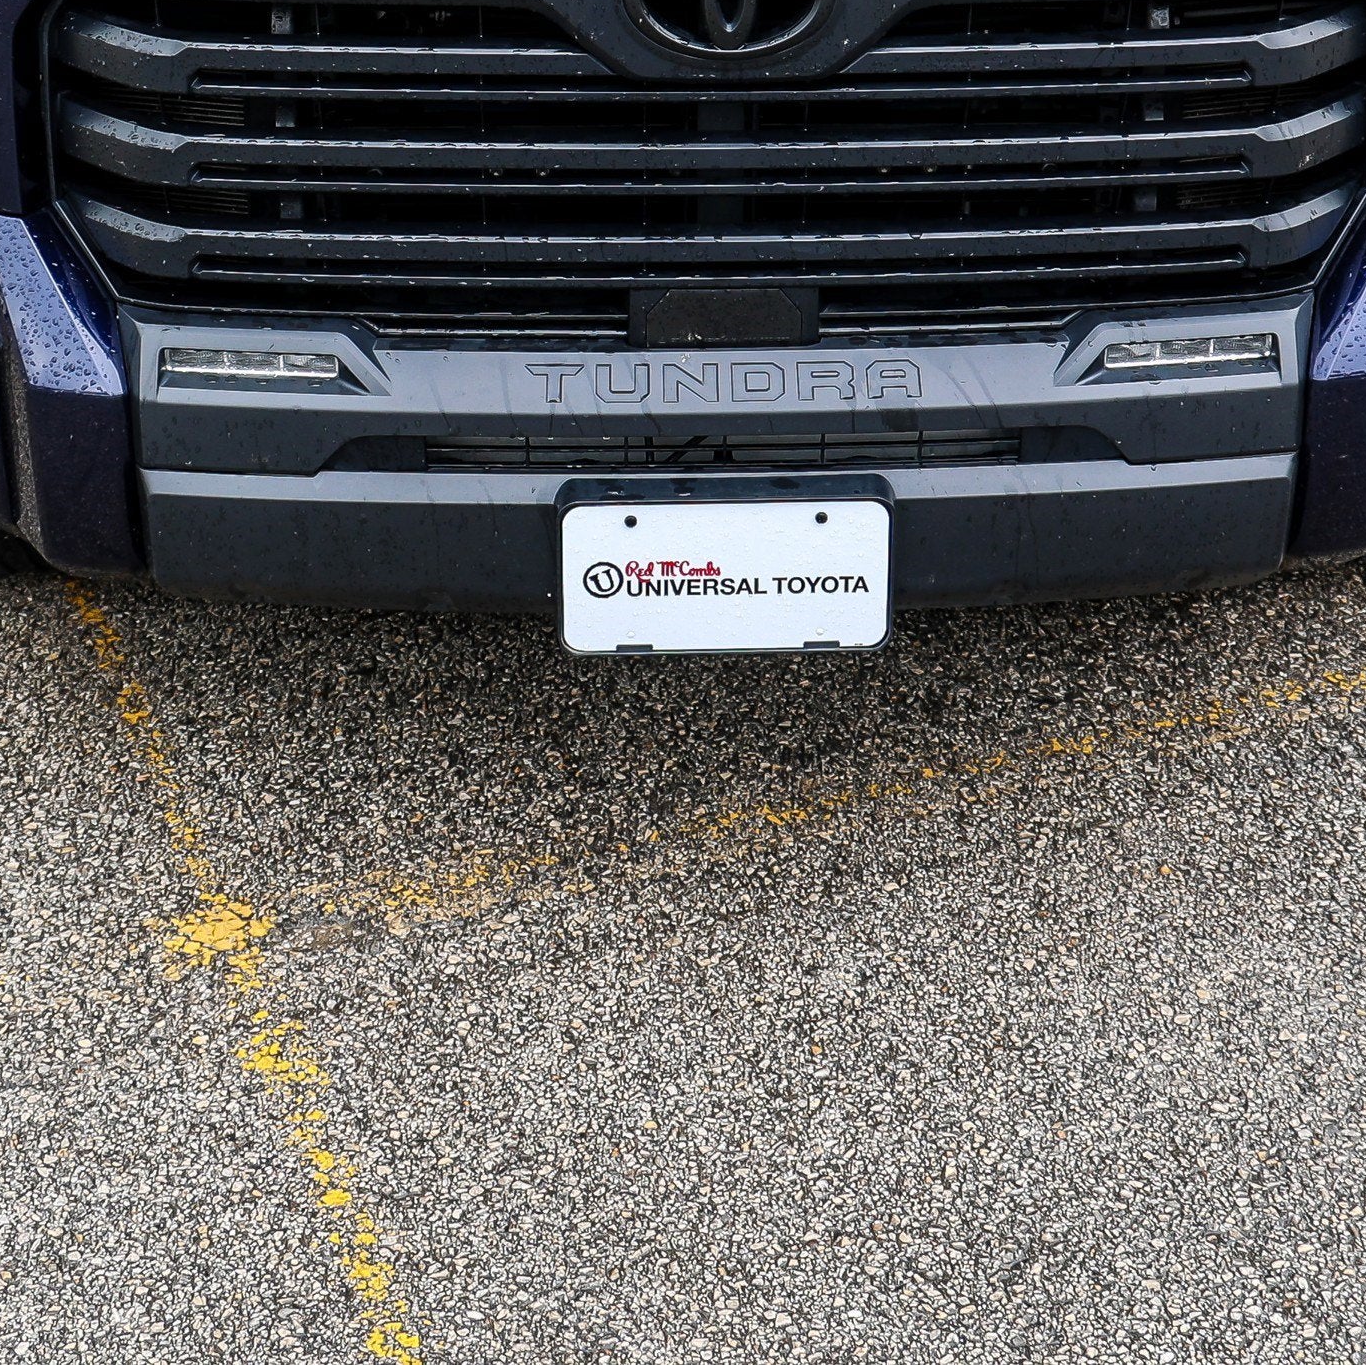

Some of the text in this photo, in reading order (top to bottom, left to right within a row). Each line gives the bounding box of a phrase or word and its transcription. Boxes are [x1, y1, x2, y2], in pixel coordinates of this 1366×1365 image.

[524, 358, 924, 404] TUNDRA
[625, 560, 655, 583] Red
[626, 576, 869, 597] UNIVERSAL TOYOTA
